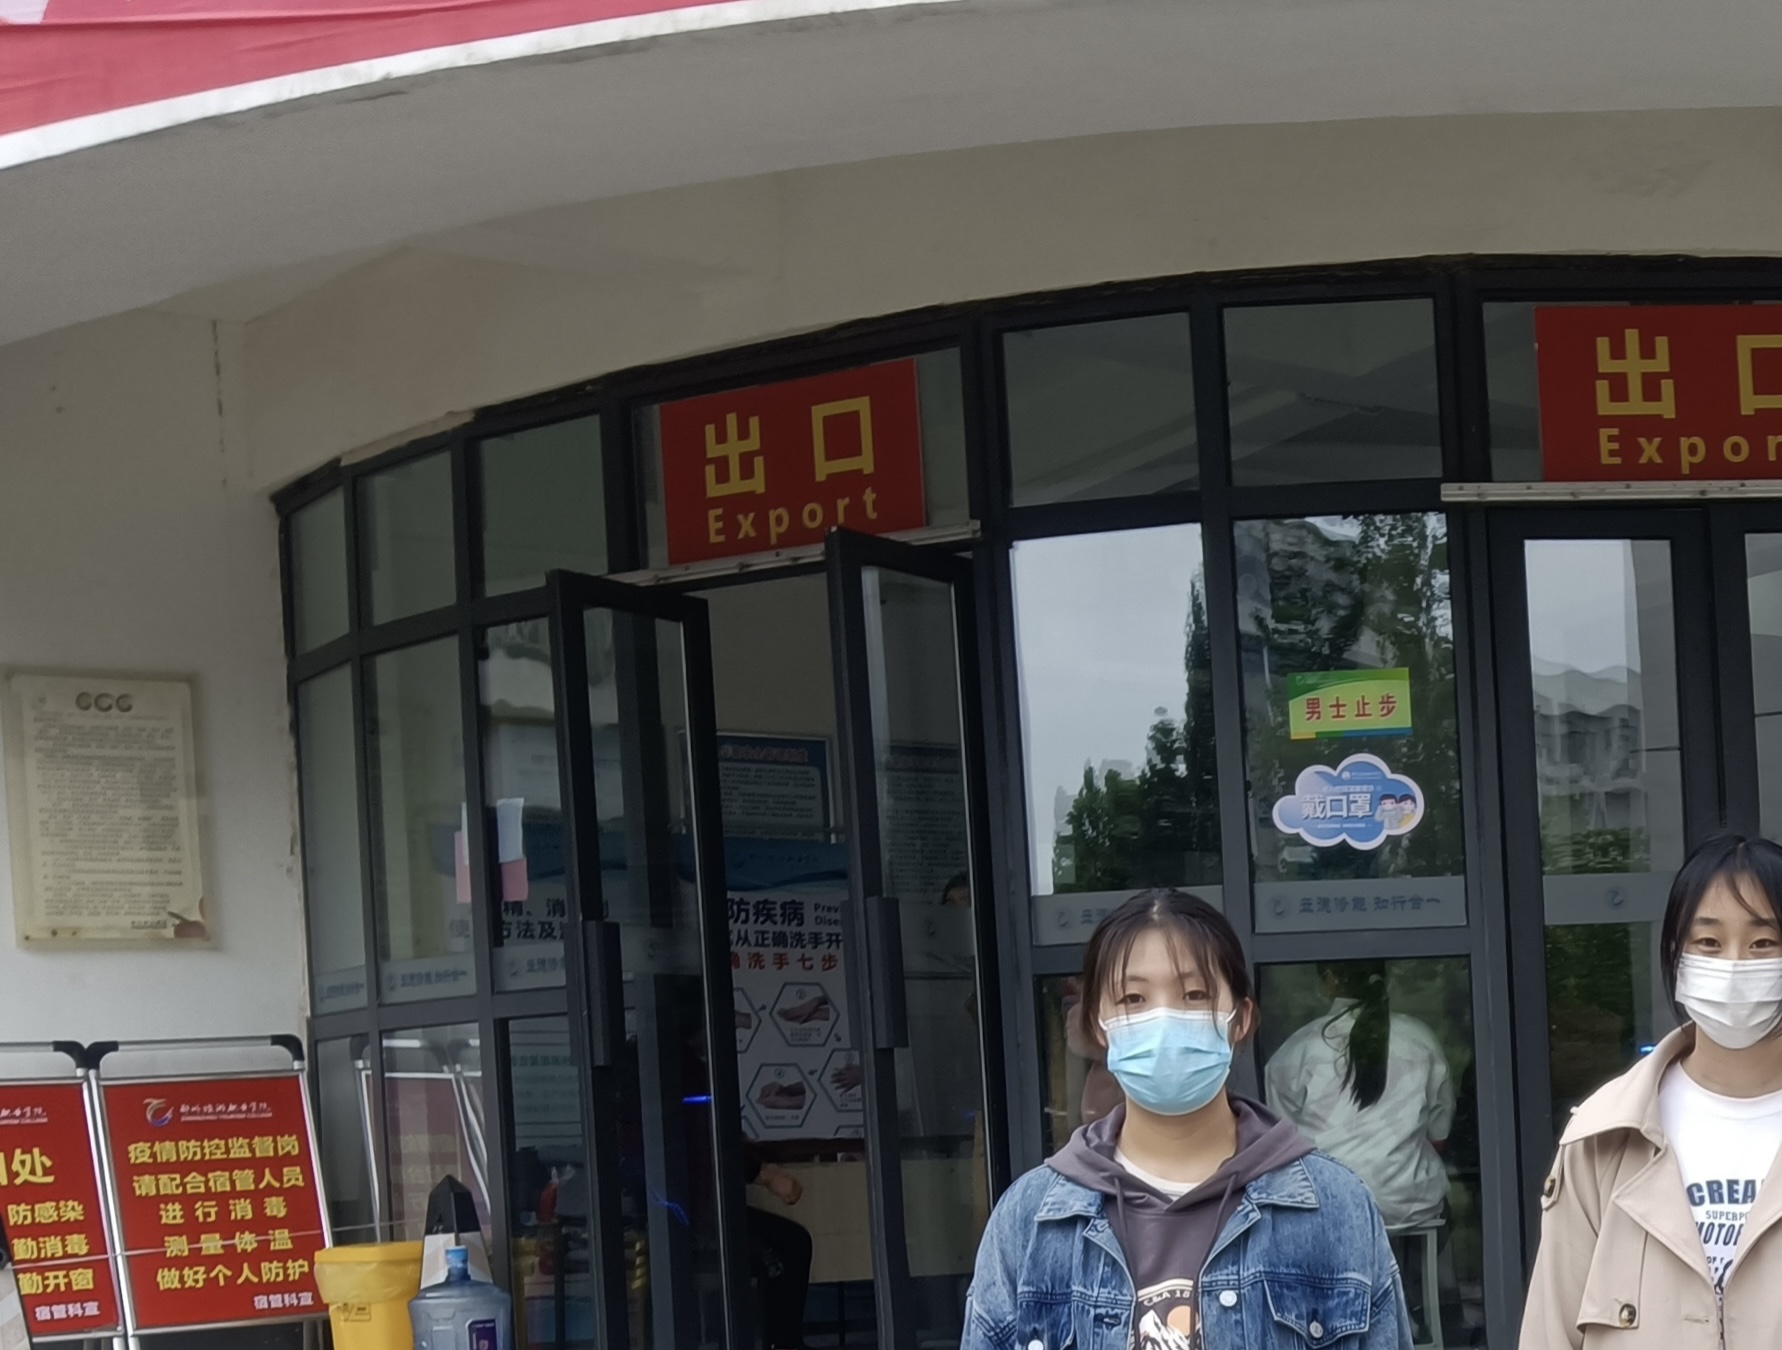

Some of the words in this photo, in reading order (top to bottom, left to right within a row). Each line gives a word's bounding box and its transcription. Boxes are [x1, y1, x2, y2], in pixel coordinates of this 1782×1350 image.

[705, 395, 874, 498] 出口
[708, 486, 877, 544] Export
[1305, 692, 1397, 721] 男士止步
[1300, 792, 1374, 820] 戴口罩
[730, 929, 843, 950] 从正确洗手开
[128, 1135, 299, 1164] 疫情防控监督岗
[133, 1166, 304, 1197] 请配合宿管人员
[1686, 1179, 1766, 1206] CREA
[7, 1199, 84, 1226] 防感染
[160, 1196, 288, 1224] 进行消毒
[12, 1233, 89, 1261] 勤消毒
[165, 1229, 293, 1257] 测量体温
[17, 1267, 94, 1295] 勤开窗
[157, 1259, 309, 1290] 做好个人防护
